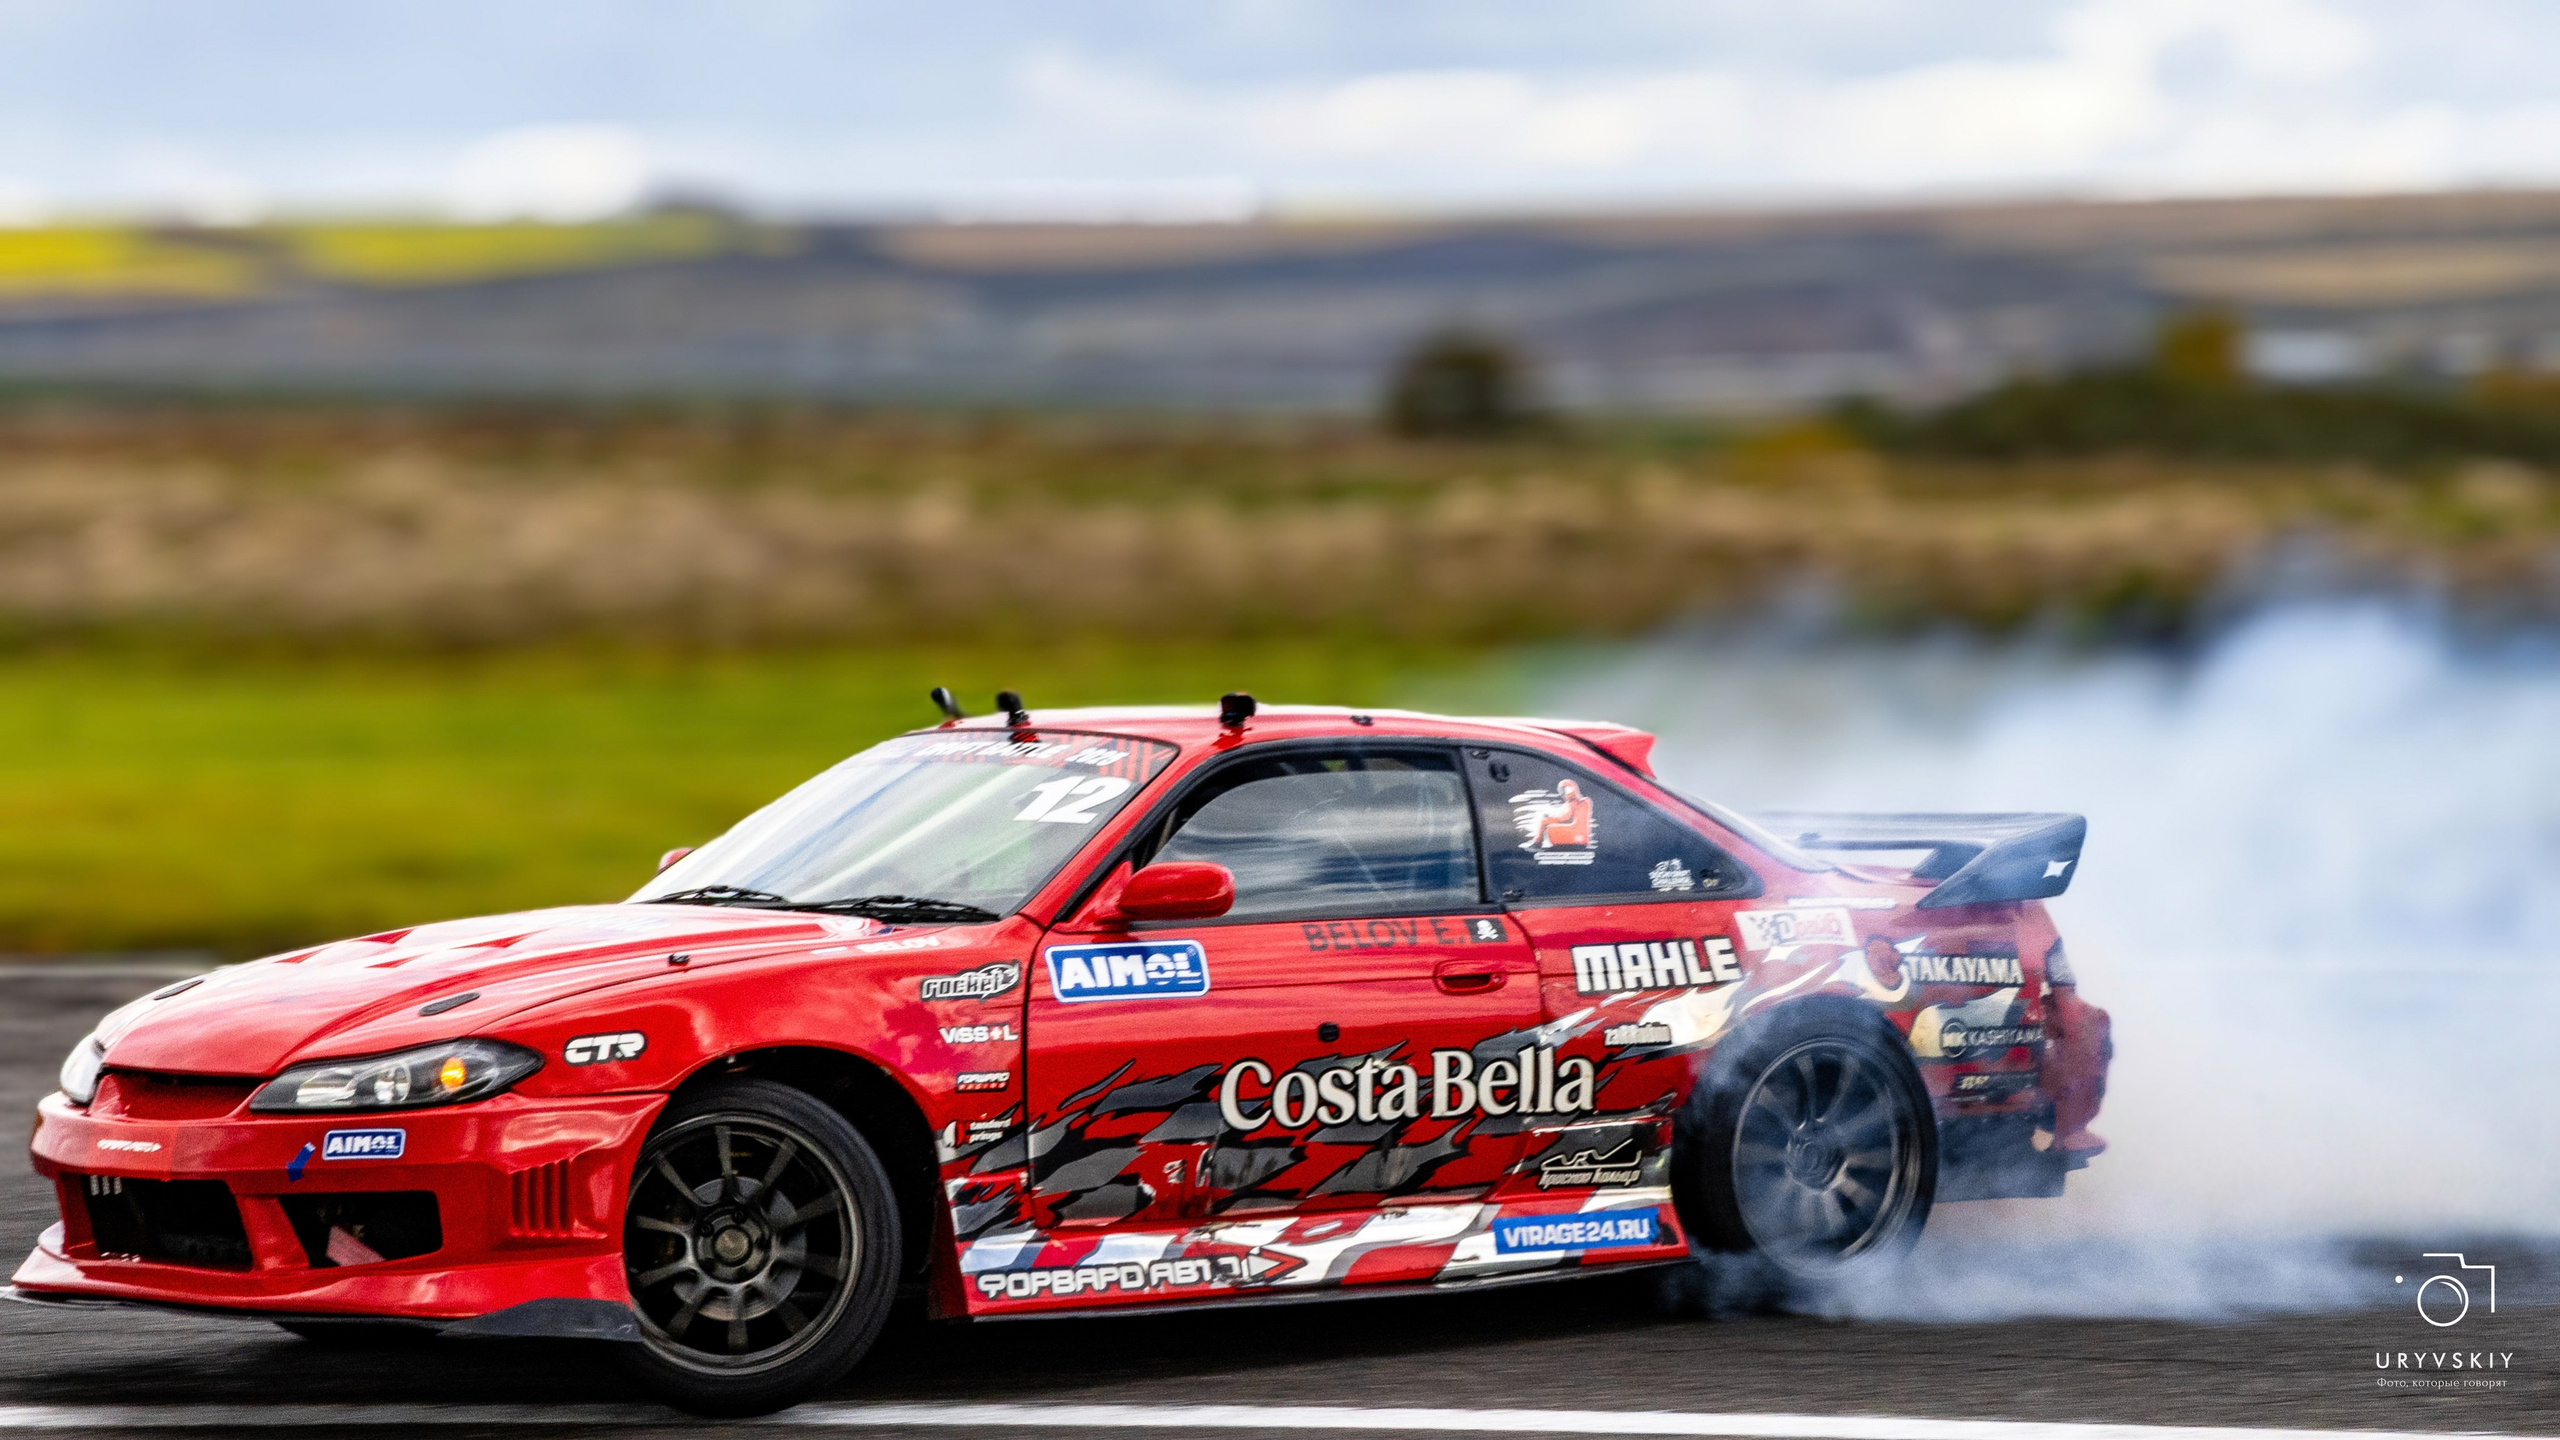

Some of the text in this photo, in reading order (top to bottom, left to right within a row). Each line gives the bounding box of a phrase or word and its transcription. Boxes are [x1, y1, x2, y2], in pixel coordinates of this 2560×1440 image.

[1013, 776, 1131, 824] 12
[1302, 918, 1465, 951] BELOV E.
[1060, 952, 1202, 989] AIMOL
[1572, 937, 1743, 993] MAHLE
[1903, 955, 2025, 985] TAKAYAMA
[565, 1033, 645, 1063] CTR
[1220, 1045, 1595, 1131] Costa Bella
[327, 1135, 400, 1154] AIMOL
[1503, 1218, 1650, 1248] VIRAGE24.RU
